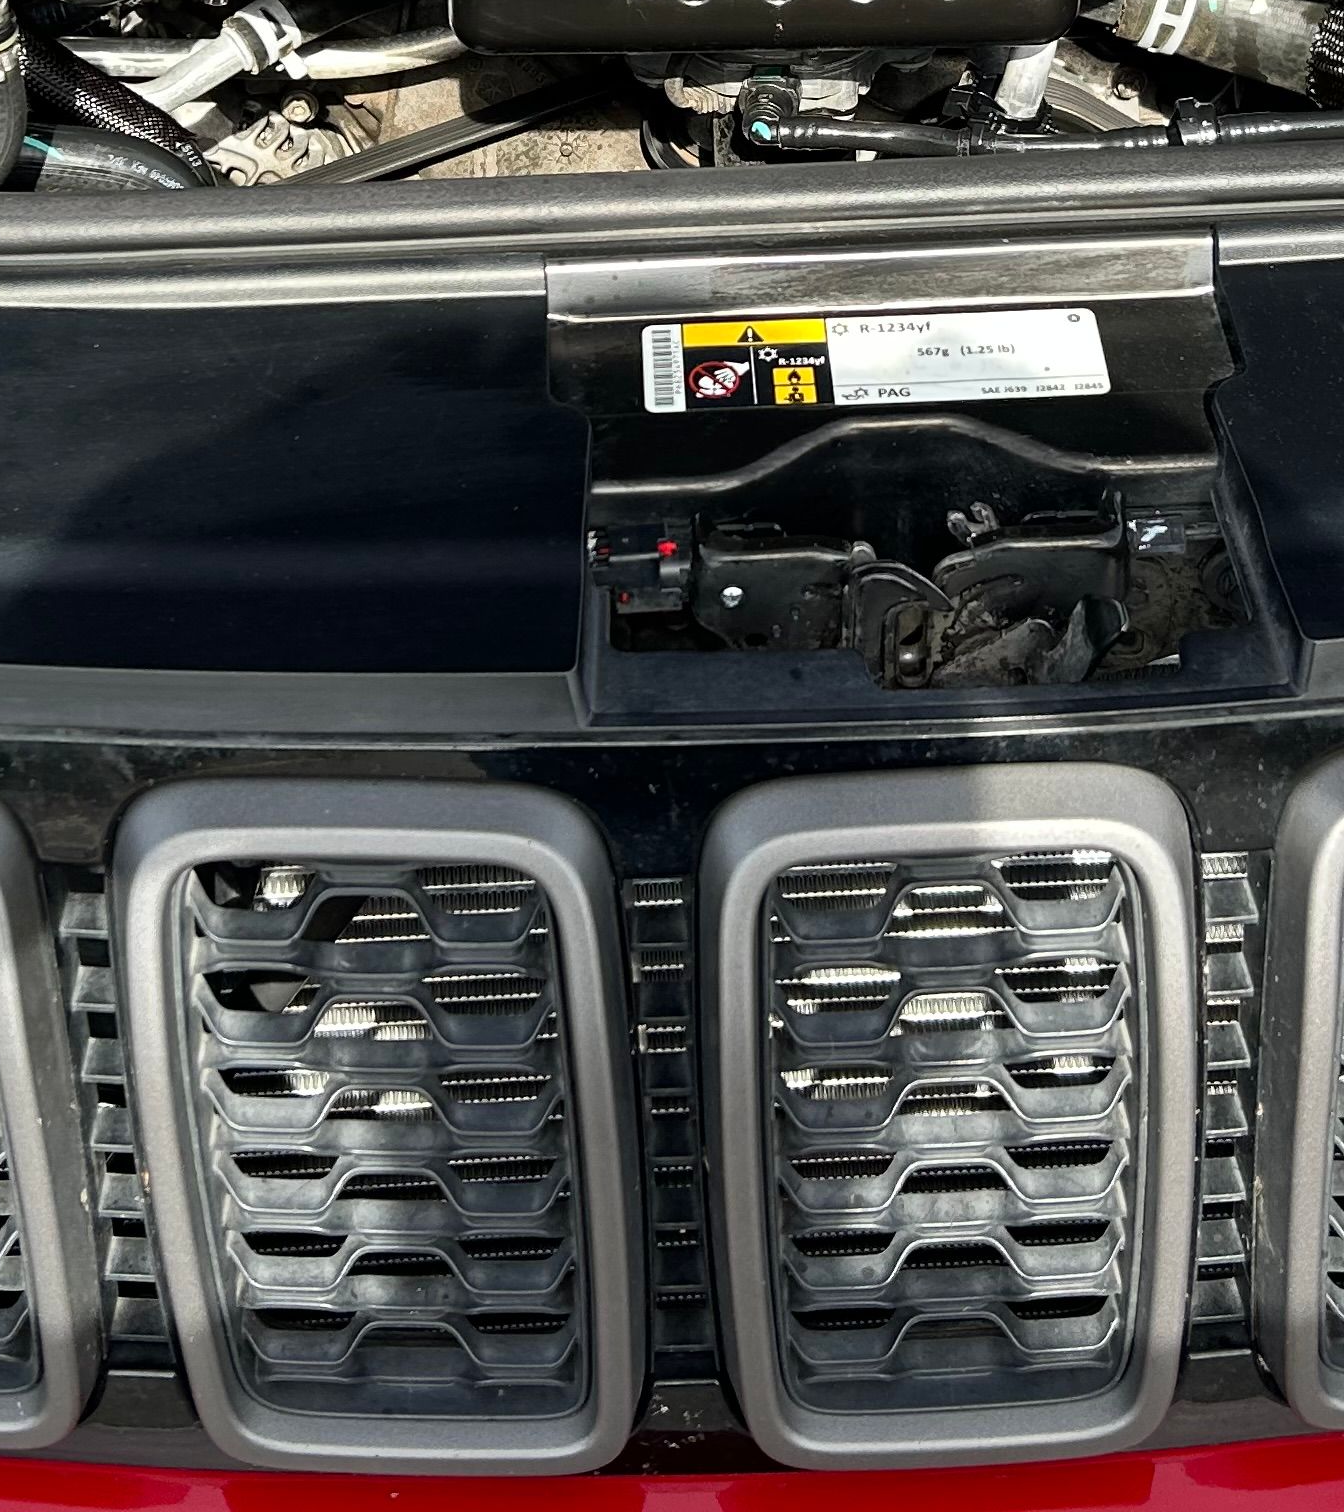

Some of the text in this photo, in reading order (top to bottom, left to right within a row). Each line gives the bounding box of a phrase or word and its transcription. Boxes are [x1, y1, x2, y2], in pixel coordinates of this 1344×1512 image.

[859, 321, 931, 335] R-1234yf
[917, 344, 1016, 358] 567g (1.25 lb)
[778, 355, 825, 366] R-1234yf
[878, 387, 911, 398] PAG
[981, 386, 1000, 394] SAE
